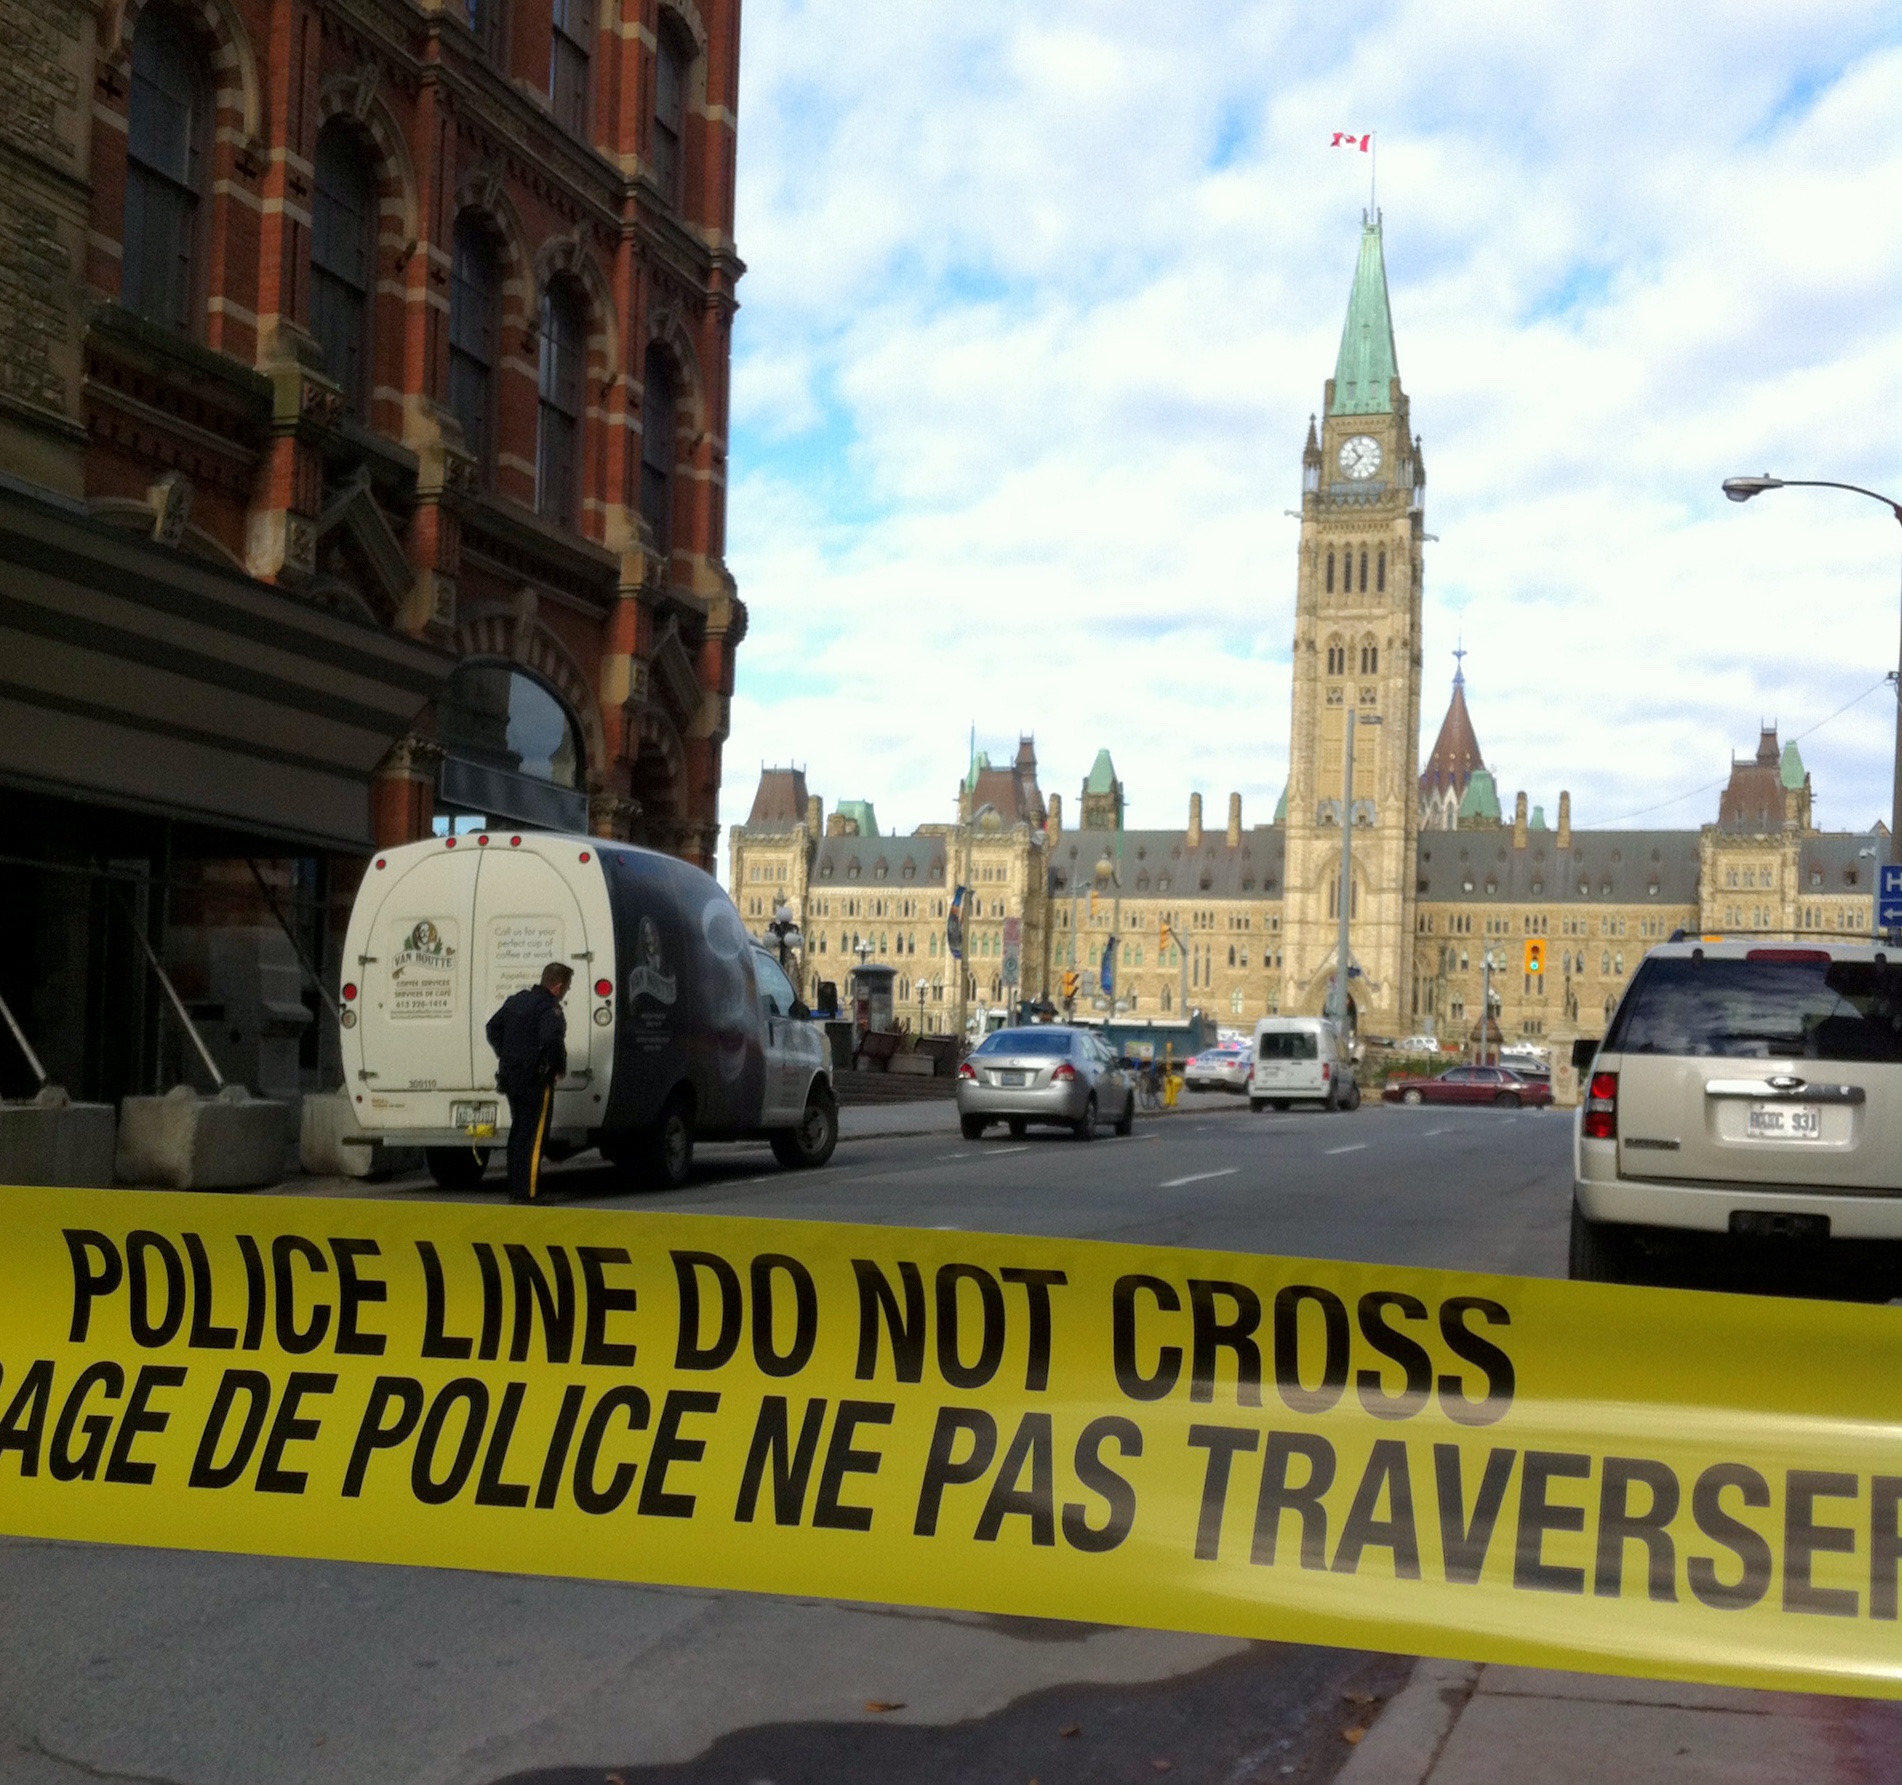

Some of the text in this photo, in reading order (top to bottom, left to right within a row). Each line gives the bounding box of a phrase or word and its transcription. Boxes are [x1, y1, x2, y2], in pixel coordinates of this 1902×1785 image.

[494, 927, 512, 936] Call
[524, 926, 536, 935] for
[538, 928, 556, 938] your
[497, 937, 554, 950] perfect cup of
[395, 952, 452, 968] VAN HOUTTE
[495, 949, 521, 960] coffee
[533, 949, 553, 958] work
[408, 1079, 437, 1089] 300110
[1792, 1113, 1817, 1131] 931
[62, 1229, 1516, 1426] POLICE LINE DO NOT CROSS
[0, 1359, 188, 1485] AGE
[188, 1369, 338, 1494] DE
[341, 1376, 721, 1518] POLICE
[734, 1395, 895, 1532] NE
[914, 1407, 1143, 1553] PAS
